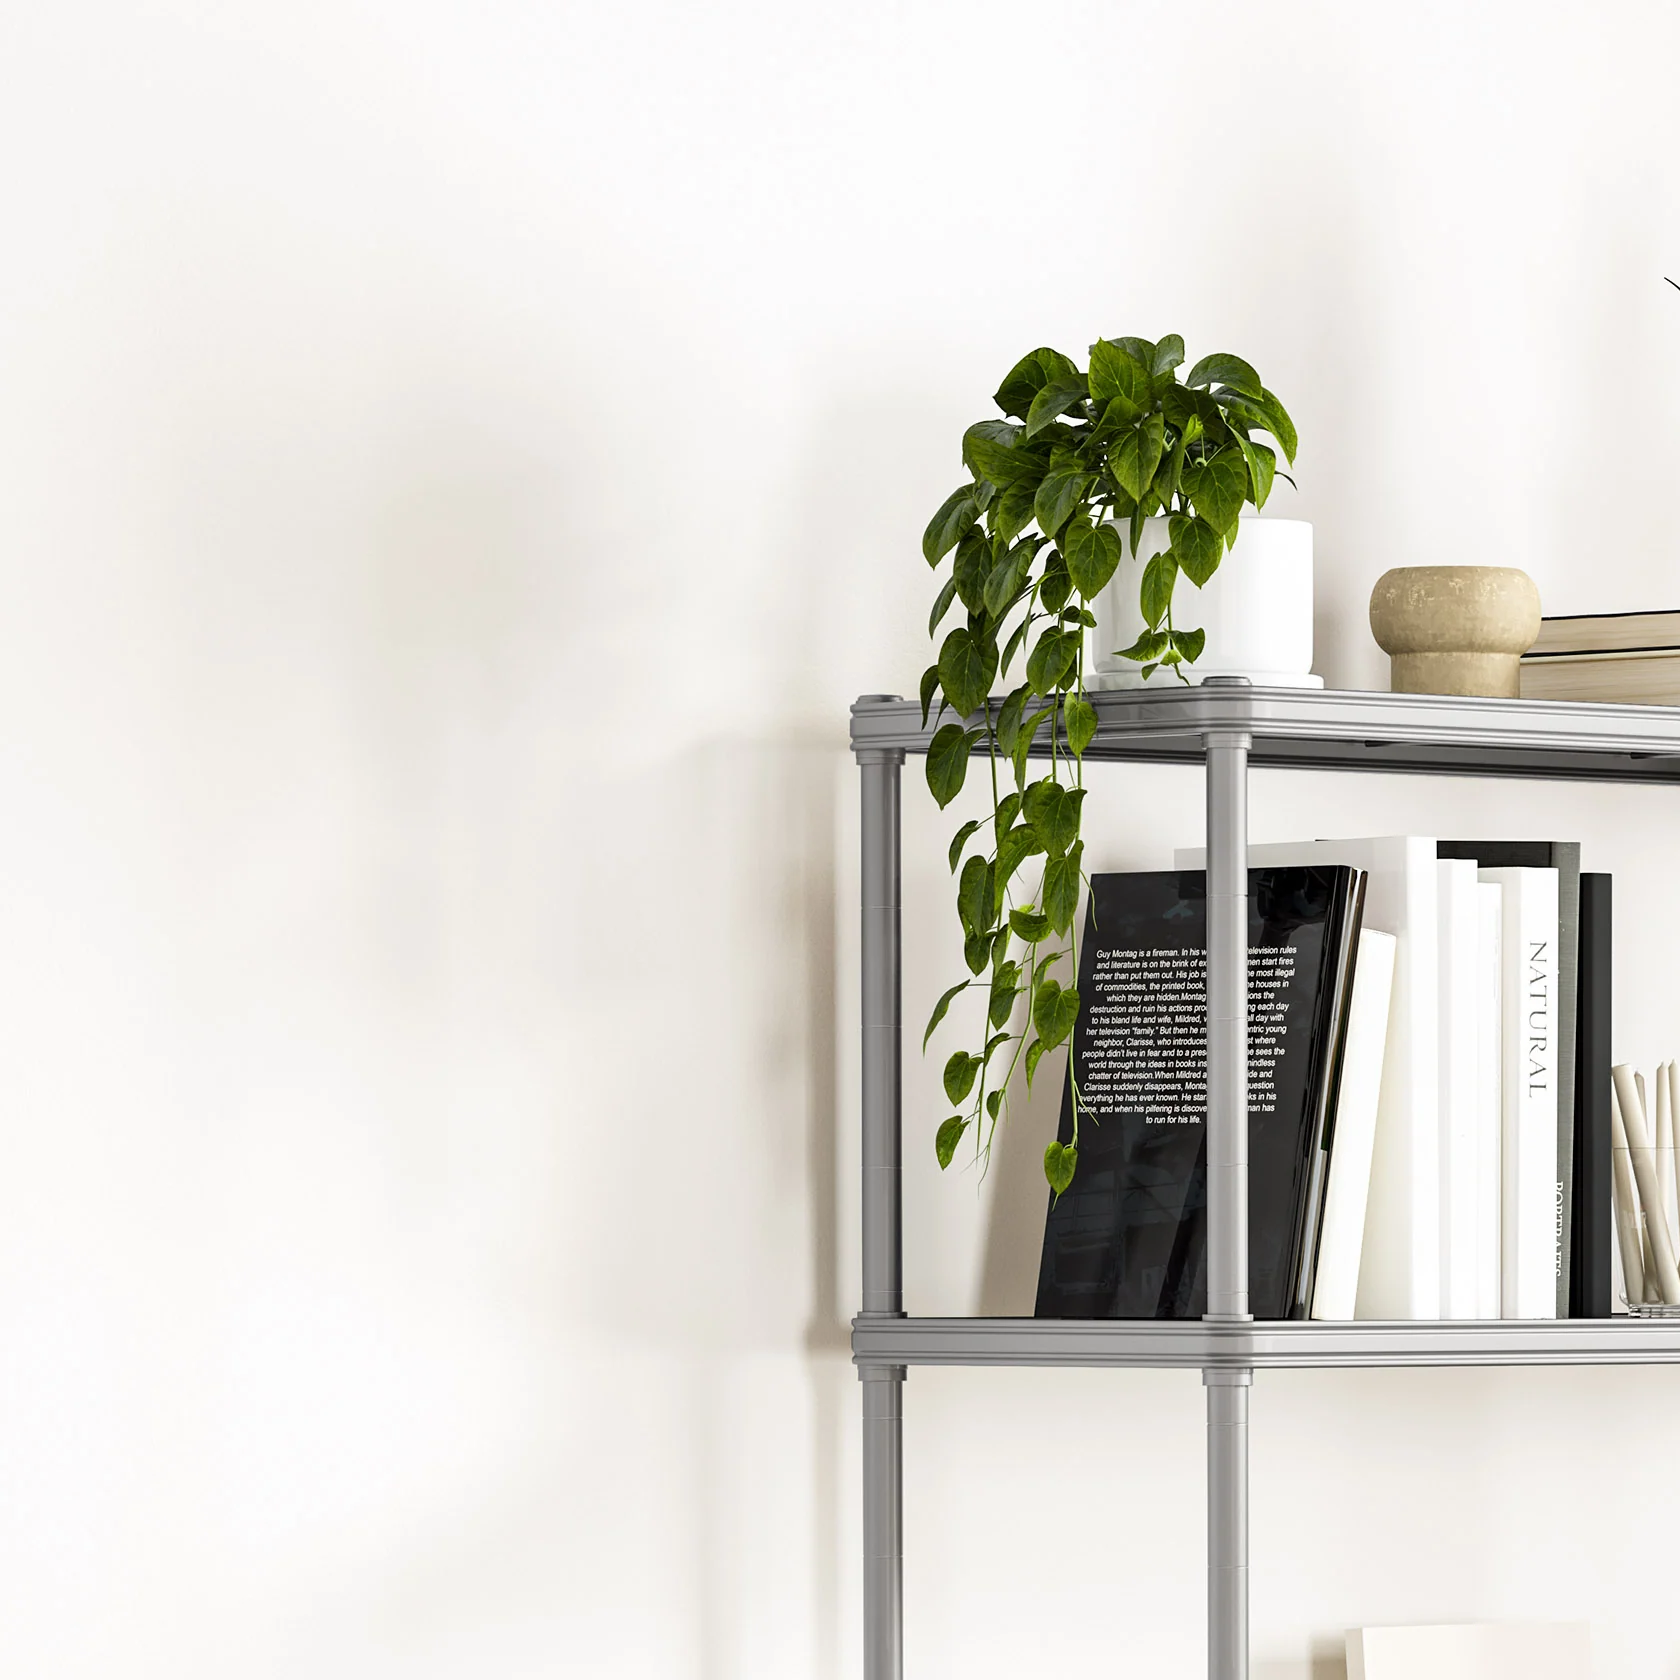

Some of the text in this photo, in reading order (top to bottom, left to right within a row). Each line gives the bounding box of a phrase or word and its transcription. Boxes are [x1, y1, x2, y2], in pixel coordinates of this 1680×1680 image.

[1097, 950, 1111, 960] Guy
[1112, 949, 1137, 960] Montag
[1139, 949, 1144, 957] is
[1152, 948, 1179, 957] fireman.
[1182, 948, 1188, 956] In
[1190, 948, 1199, 956] his
[1248, 946, 1278, 954] elevision
[1280, 945, 1297, 953] rules
[1097, 960, 1109, 969] and
[1111, 960, 1140, 968] literature
[1142, 960, 1147, 968] is
[1160, 959, 1170, 967] the
[1172, 959, 1188, 967] brink
[1190, 959, 1198, 967] of
[1262, 957, 1277, 965] start
[1279, 957, 1293, 965] fires
[1093, 972, 1112, 980] rather
[1115, 971, 1128, 979] than
[1130, 971, 1141, 981] put
[1143, 971, 1159, 979] them
[1162, 970, 1174, 978] out.
[1176, 970, 1187, 978] His
[1188, 970, 1199, 980] job
[1201, 970, 1206, 978] is
[1256, 968, 1273, 976] most
[1275, 968, 1295, 978] illegal
[1096, 983, 1102, 991] of
[1104, 982, 1147, 993] commodities,
[1150, 982, 1159, 990] the
[1162, 981, 1185, 991] printed
[1187, 981, 1205, 991] book,
[1256, 979, 1281, 987] houses
[1283, 979, 1289, 987] in
[1107, 994, 1126, 1002] which
[1128, 993, 1141, 1004] they
[1264, 991, 1274, 999] the
[1090, 1004, 1126, 1013] destruction
[1128, 1004, 1140, 1012] and
[1142, 1004, 1155, 1012] ruin
[1157, 1004, 1166, 1012] his
[1168, 1003, 1192, 1012] actions
[1257, 1002, 1274, 1010] each
[1276, 1002, 1289, 1012] day
[1092, 1016, 1098, 1024] to
[1100, 1015, 1110, 1024] his
[1112, 1015, 1130, 1023] bland
[1132, 1015, 1141, 1023] life
[1143, 1015, 1156, 1023] and
[1158, 1015, 1173, 1025] wife,
[1175, 1014, 1201, 1024] Mildred,
[1256, 1013, 1268, 1023] day
[1270, 1013, 1284, 1021] with
[1529, 942, 1547, 1098] NATURAL
[1086, 1027, 1097, 1035] her
[1099, 1027, 1130, 1035] television
[1160, 1026, 1171, 1034] But
[1173, 1026, 1188, 1034] then
[1190, 1025, 1198, 1034] he
[1265, 1026, 1287, 1034] young
[1094, 1038, 1124, 1048] neighbor,
[1126, 1037, 1155, 1048] Clarisse,
[1157, 1037, 1171, 1045] who
[1173, 1037, 1207, 1045] introduces
[1255, 1036, 1276, 1044] where
[1082, 1049, 1105, 1059] people
[1126, 1048, 1137, 1056] live
[1139, 1048, 1145, 1056] in
[1147, 1048, 1160, 1056] fear
[1162, 1048, 1175, 1056] and
[1177, 1048, 1183, 1056] to
[1274, 1047, 1285, 1055] the
[1089, 1060, 1106, 1068] world
[1108, 1060, 1134, 1070] through
[1136, 1059, 1146, 1068] the
[1148, 1059, 1166, 1067] ideas
[1168, 1059, 1174, 1067] in
[1176, 1059, 1196, 1067] books
[1089, 1071, 1112, 1079] chatter
[1113, 1071, 1120, 1079] of
[1176, 1070, 1200, 1078] Mildred
[1259, 1069, 1272, 1078] and
[1084, 1082, 1111, 1090] Clarisse
[1113, 1082, 1143, 1092] suddenly
[1145, 1082, 1183, 1092] disappears,
[1185, 1081, 1207, 1090] Monta
[1115, 1093, 1123, 1101] he
[1125, 1093, 1137, 1101] has
[1156, 1093, 1179, 1101] known.
[1182, 1093, 1191, 1101] He
[1258, 1092, 1264, 1100] in
[1266, 1092, 1276, 1100] his
[1100, 1104, 1113, 1112] and
[1115, 1104, 1133, 1112] when
[1134, 1104, 1144, 1112] his
[1146, 1104, 1171, 1114] pilfering
[1174, 1104, 1180, 1112] is
[1182, 1103, 1207, 1112] discove
[1262, 1103, 1275, 1111] has
[1146, 1115, 1153, 1123] to
[1167, 1115, 1176, 1123] for
[1178, 1115, 1188, 1123] his
[1190, 1115, 1201, 1123] life.
